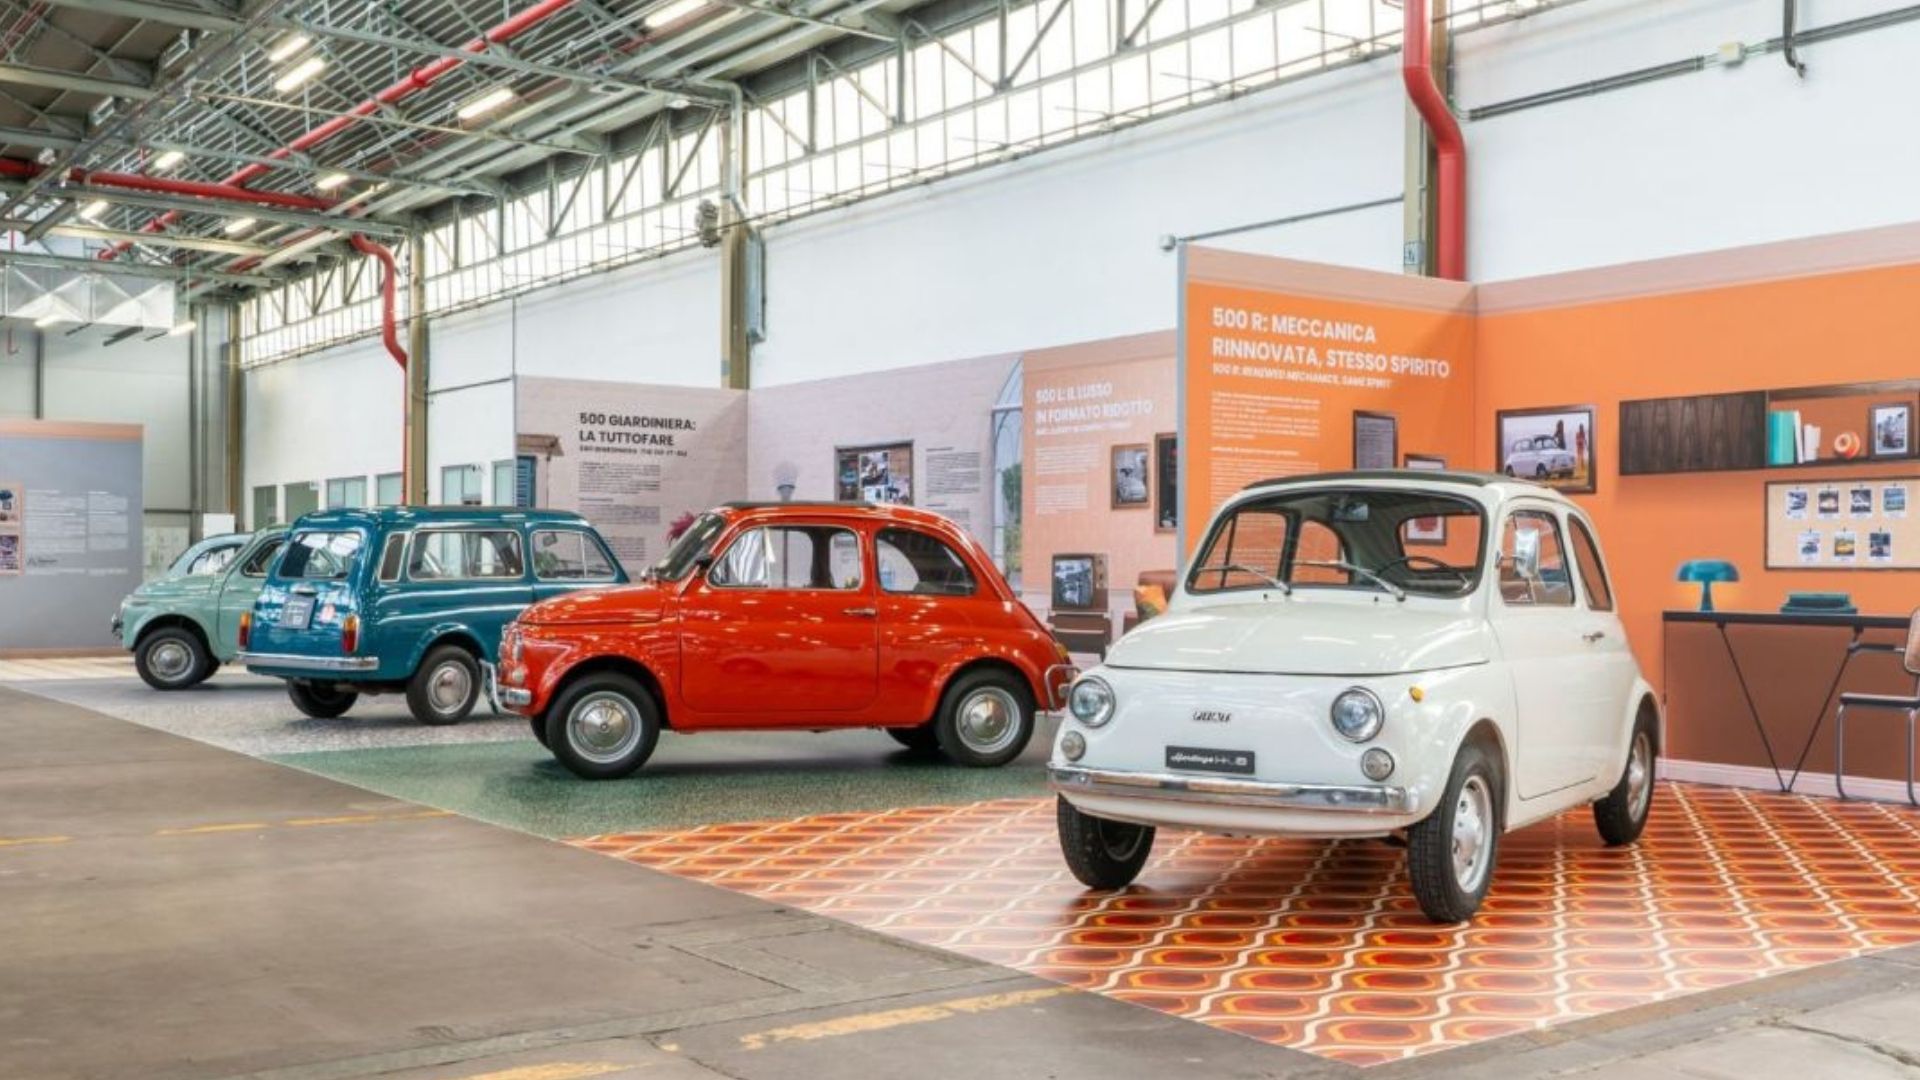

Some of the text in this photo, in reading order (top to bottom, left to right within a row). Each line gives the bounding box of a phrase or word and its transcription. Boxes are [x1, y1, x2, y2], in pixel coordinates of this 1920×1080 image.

[1212, 307, 1376, 343] 500 R: MECCANICA
[1212, 337, 1449, 378] RINNOVATA, STESSO SPIRITO
[580, 412, 696, 430] 500 GIARDINIERA:
[1048, 404, 1101, 422] FORMATO
[1103, 399, 1154, 416] RIDOTTO
[579, 430, 674, 446] LA TUTTOFARE
